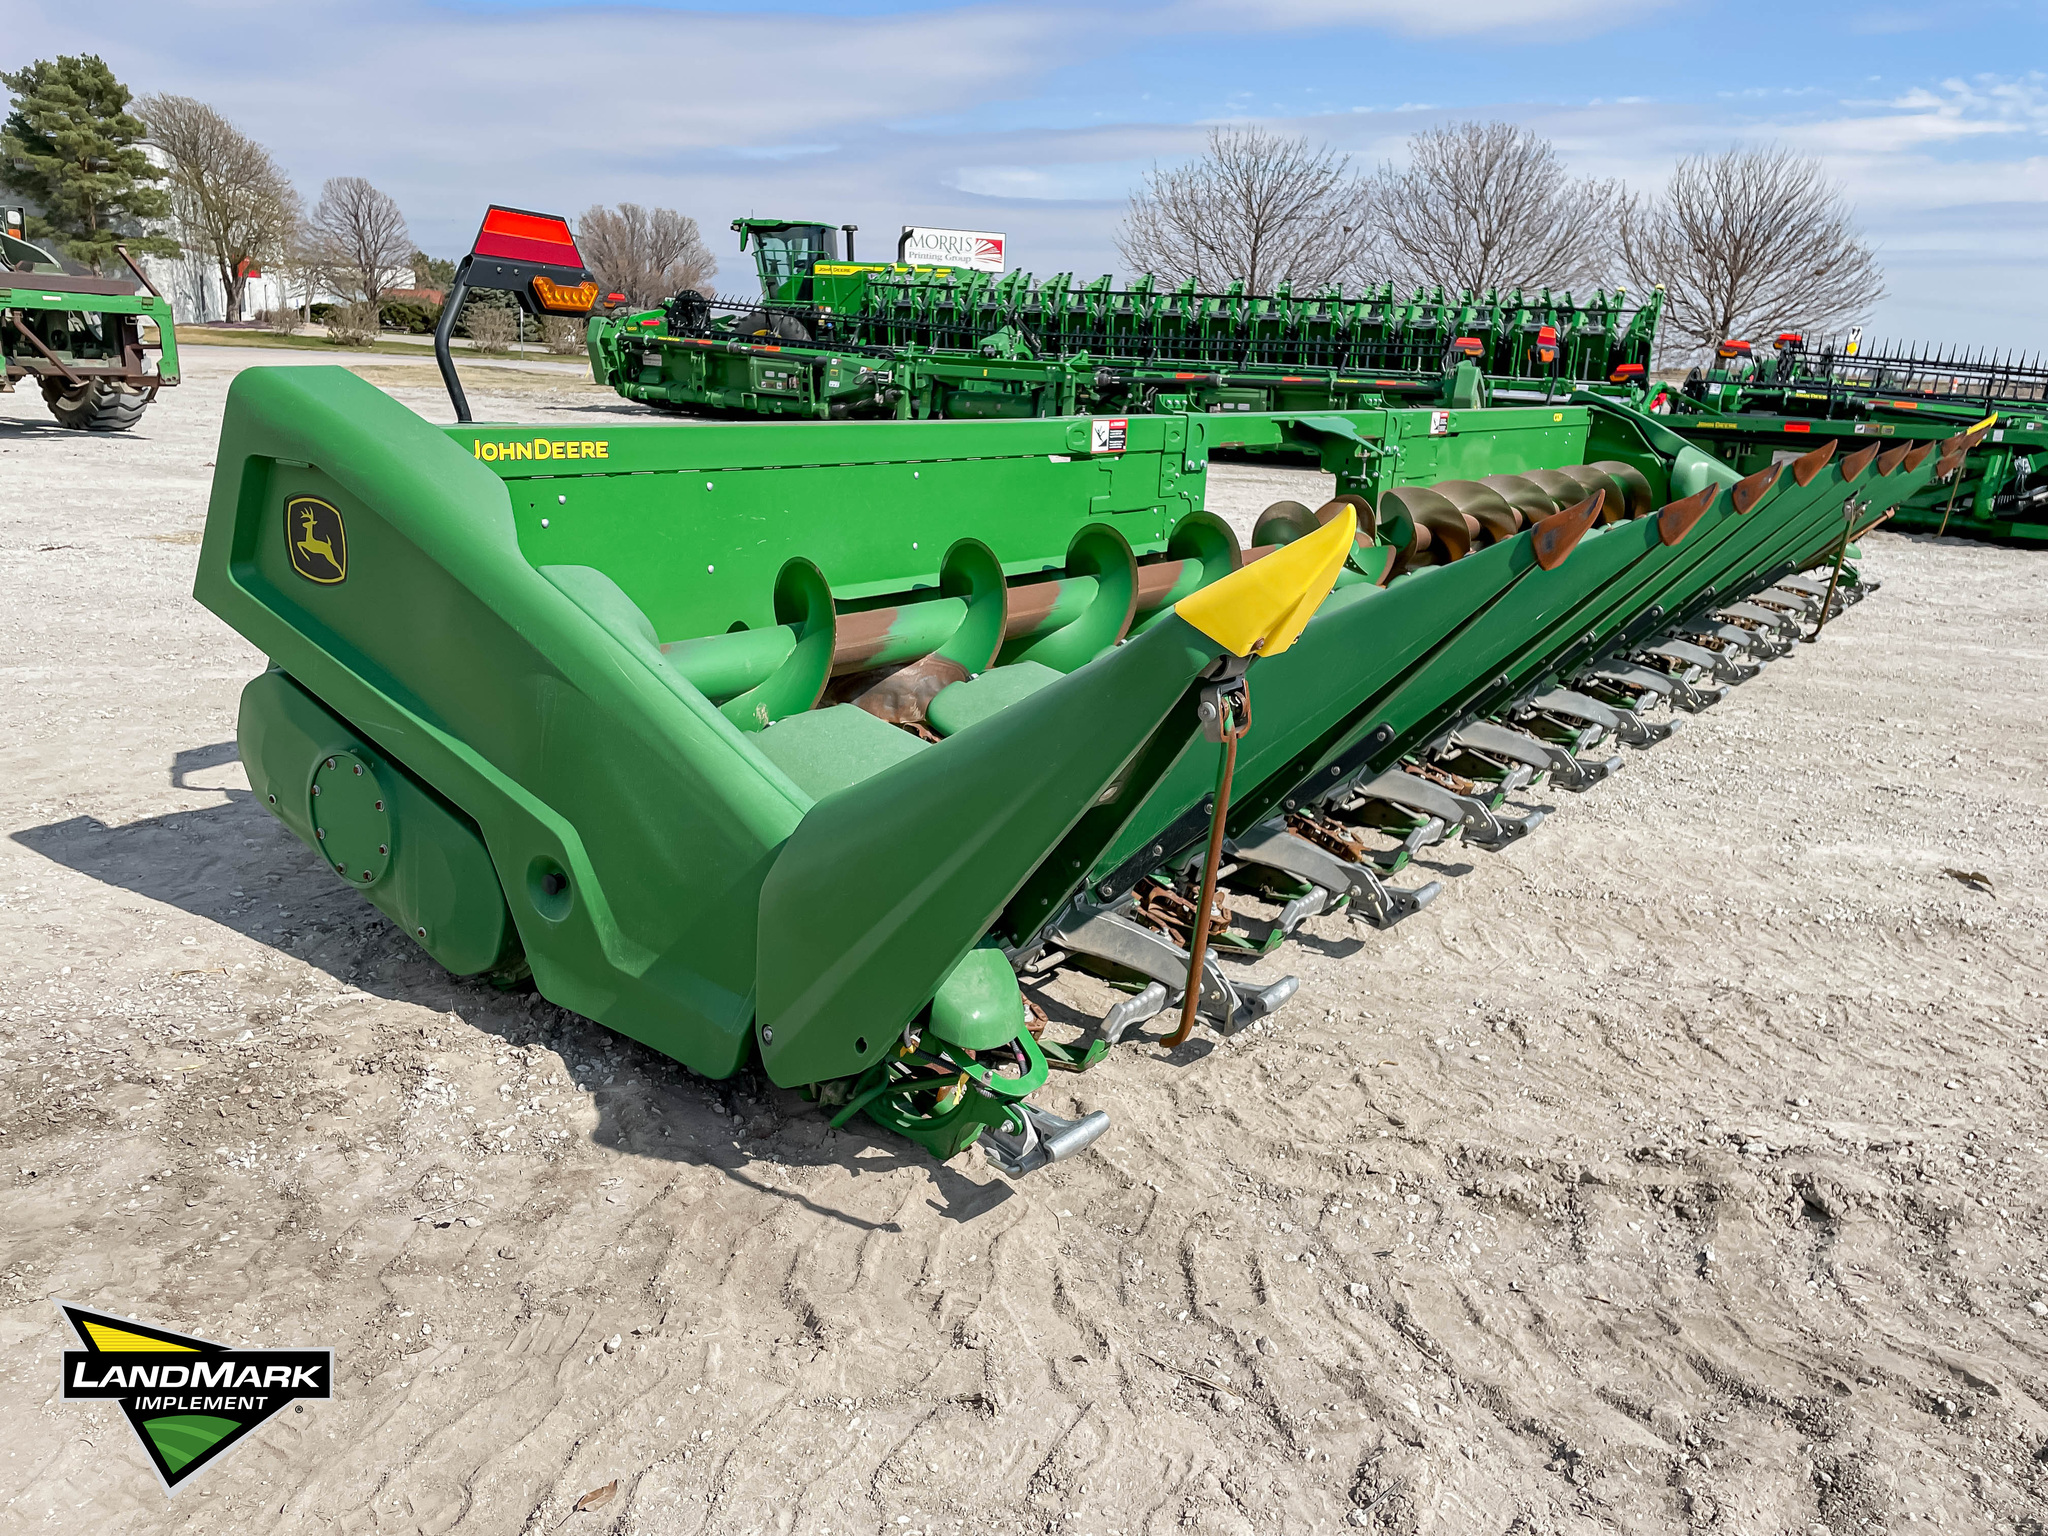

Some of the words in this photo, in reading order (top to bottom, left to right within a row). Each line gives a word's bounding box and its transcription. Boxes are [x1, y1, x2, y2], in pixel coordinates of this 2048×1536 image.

[909, 234, 973, 254] MORRIS
[908, 251, 943, 262] Printing
[945, 253, 972, 264] Group
